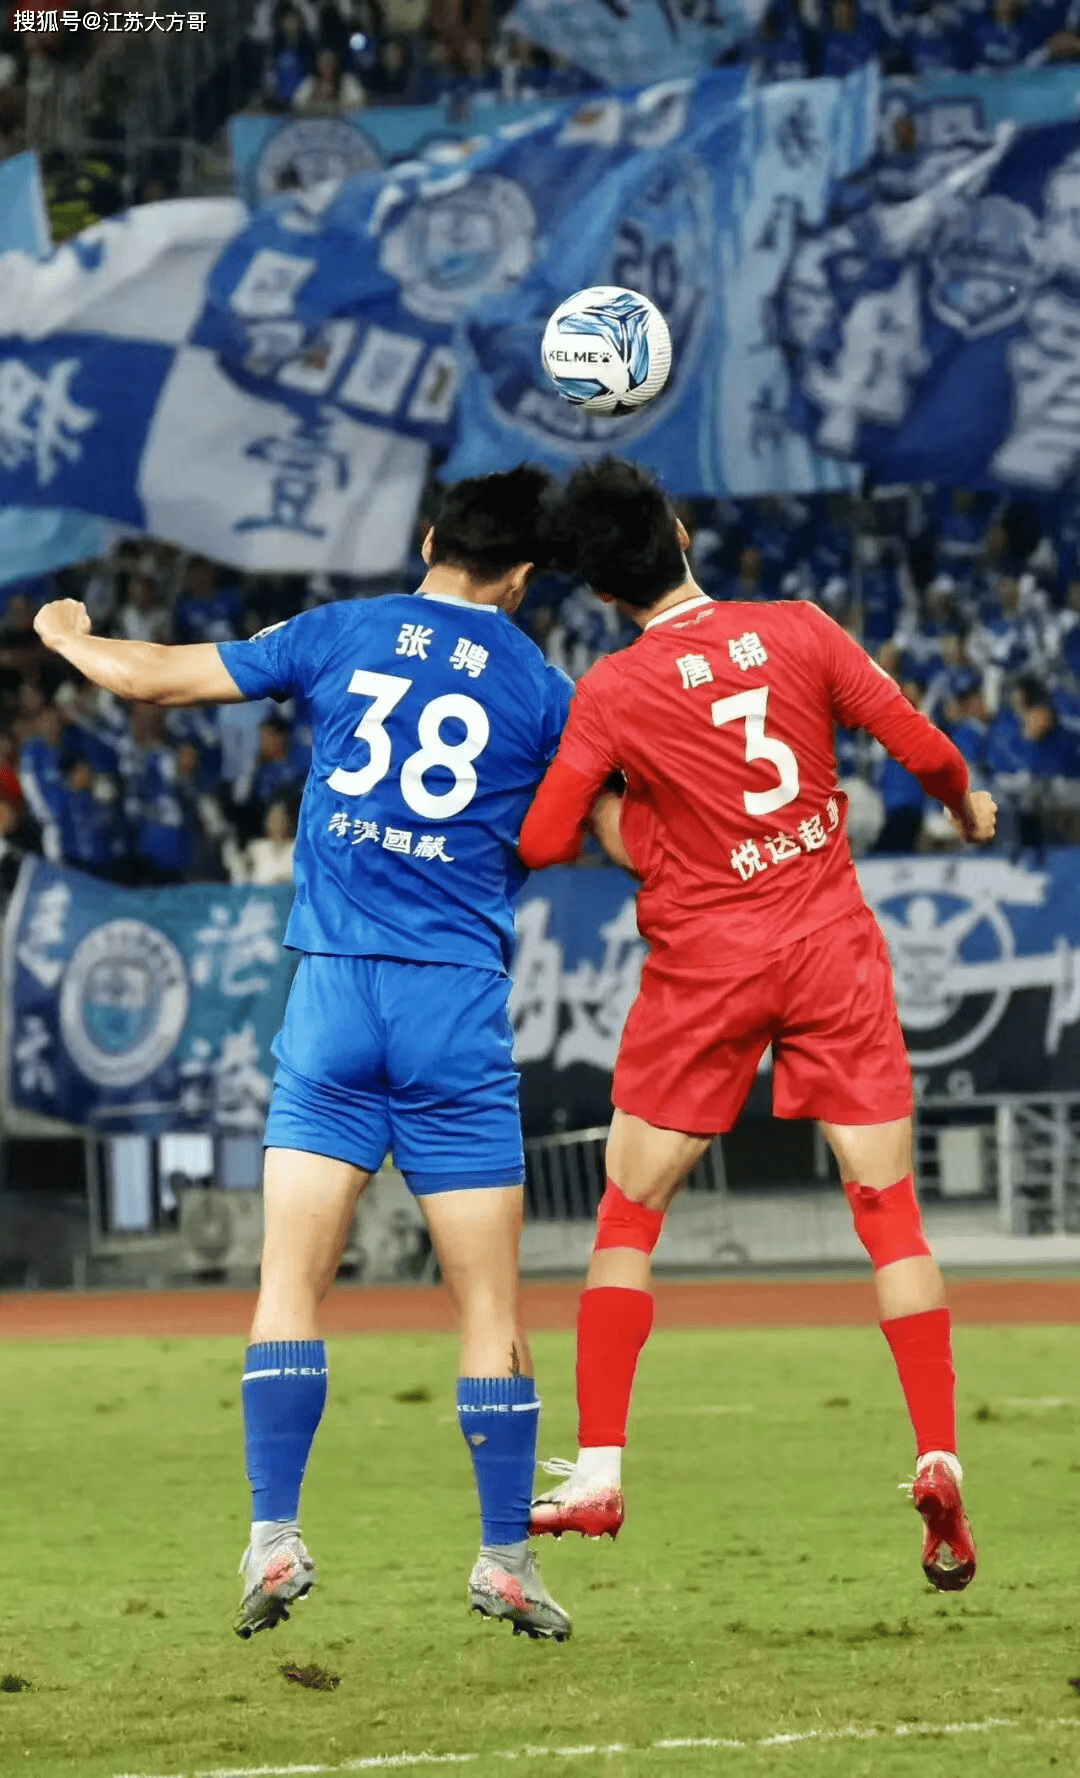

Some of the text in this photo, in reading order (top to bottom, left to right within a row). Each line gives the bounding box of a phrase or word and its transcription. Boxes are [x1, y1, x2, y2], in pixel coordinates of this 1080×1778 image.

[549, 350, 599, 363] KELME
[676, 632, 768, 689] 唐锦
[327, 668, 490, 820] 38
[711, 685, 800, 815] 3
